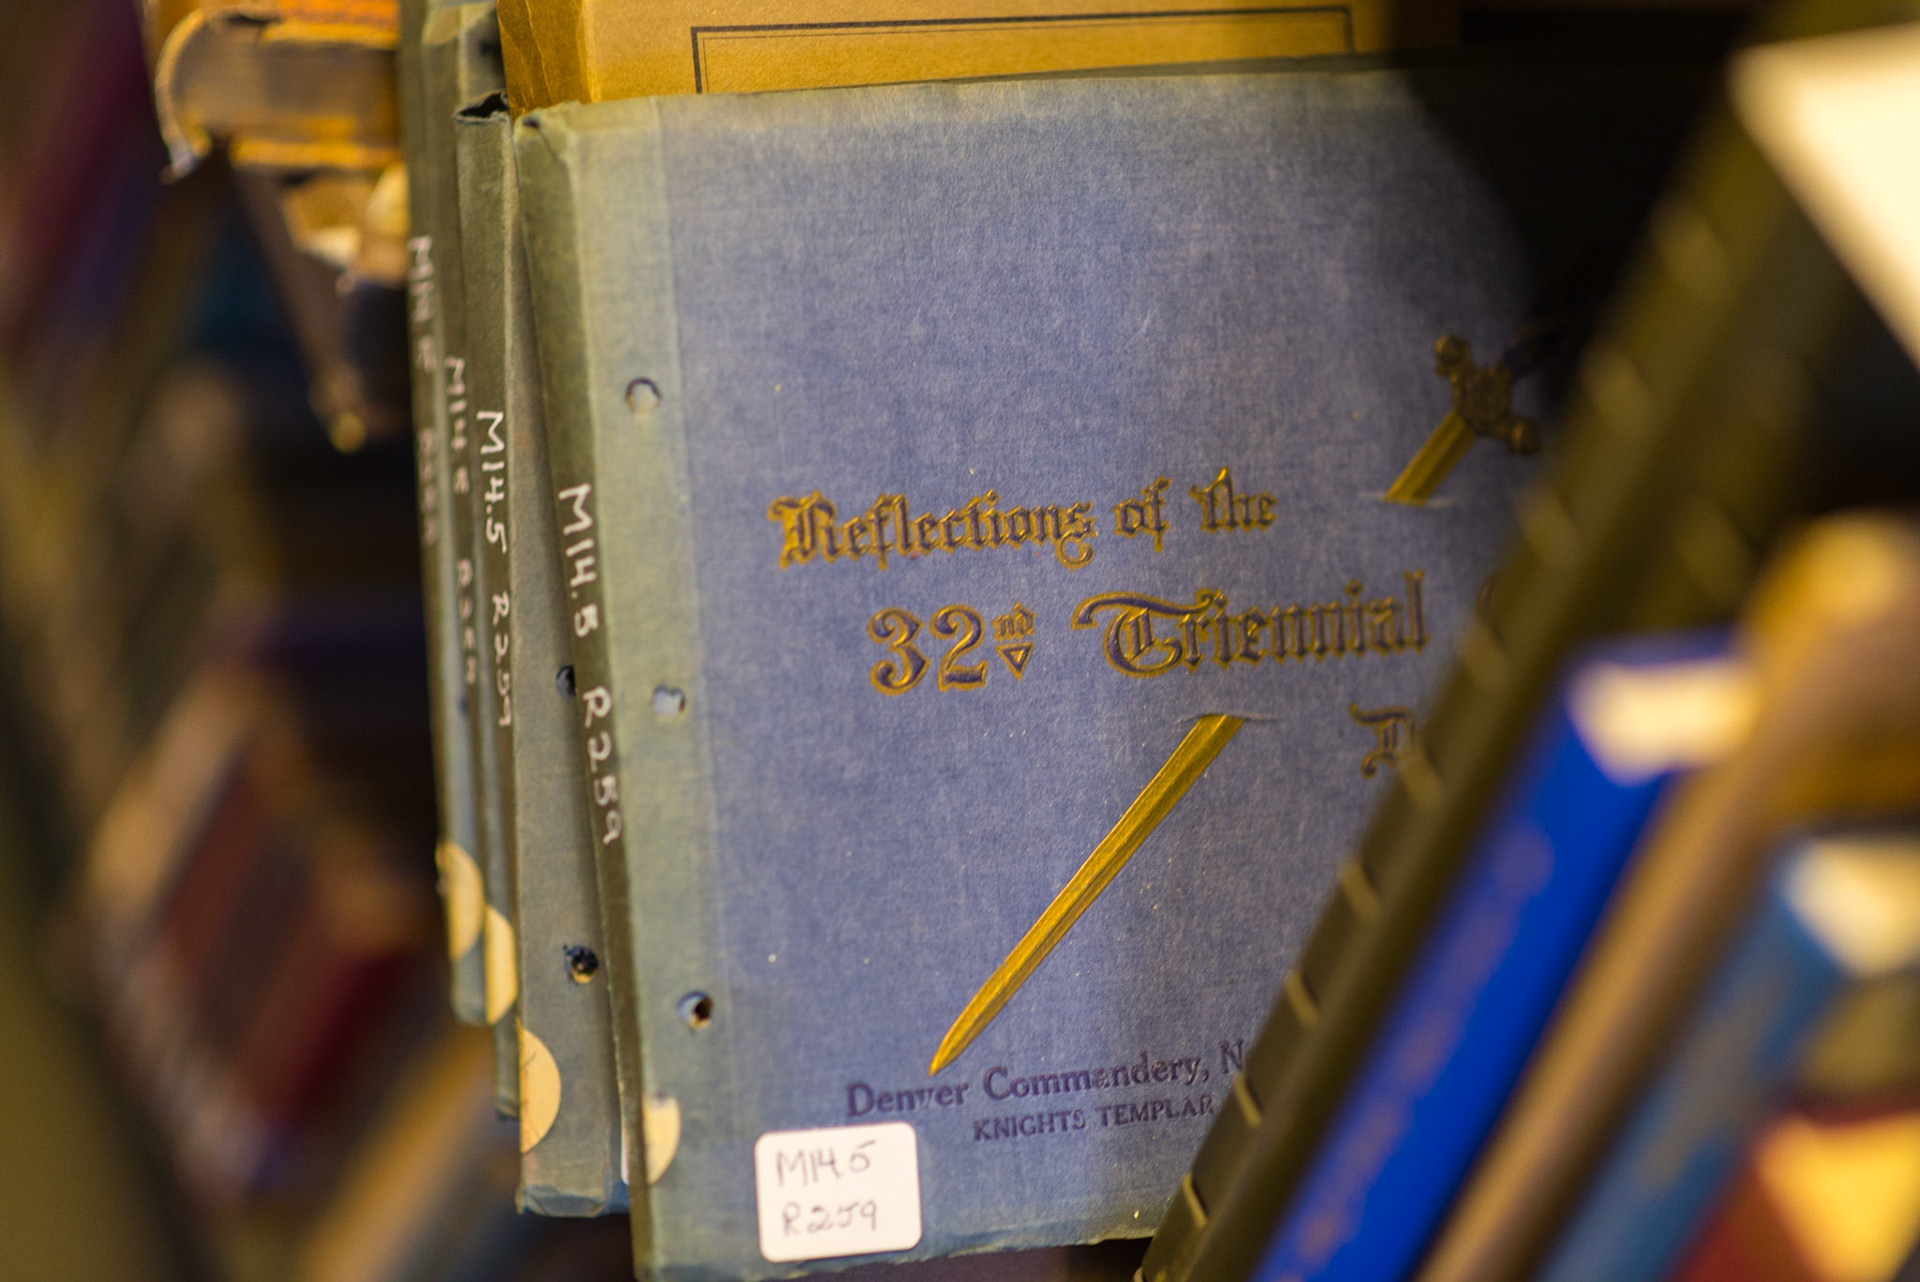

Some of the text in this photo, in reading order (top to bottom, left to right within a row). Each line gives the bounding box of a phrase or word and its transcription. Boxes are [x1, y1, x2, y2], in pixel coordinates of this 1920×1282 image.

[476, 411, 508, 554] M14.5
[768, 466, 1278, 571] Reflections of the
[558, 482, 623, 845] M14.5 R259
[1070, 569, 1430, 680] Triennial
[846, 1080, 969, 1118] Denver
[983, 1050, 1210, 1102] Commandery,
[972, 1094, 1215, 1141] KNIGHTS TEMPLAR
[782, 1199, 878, 1237] R259
